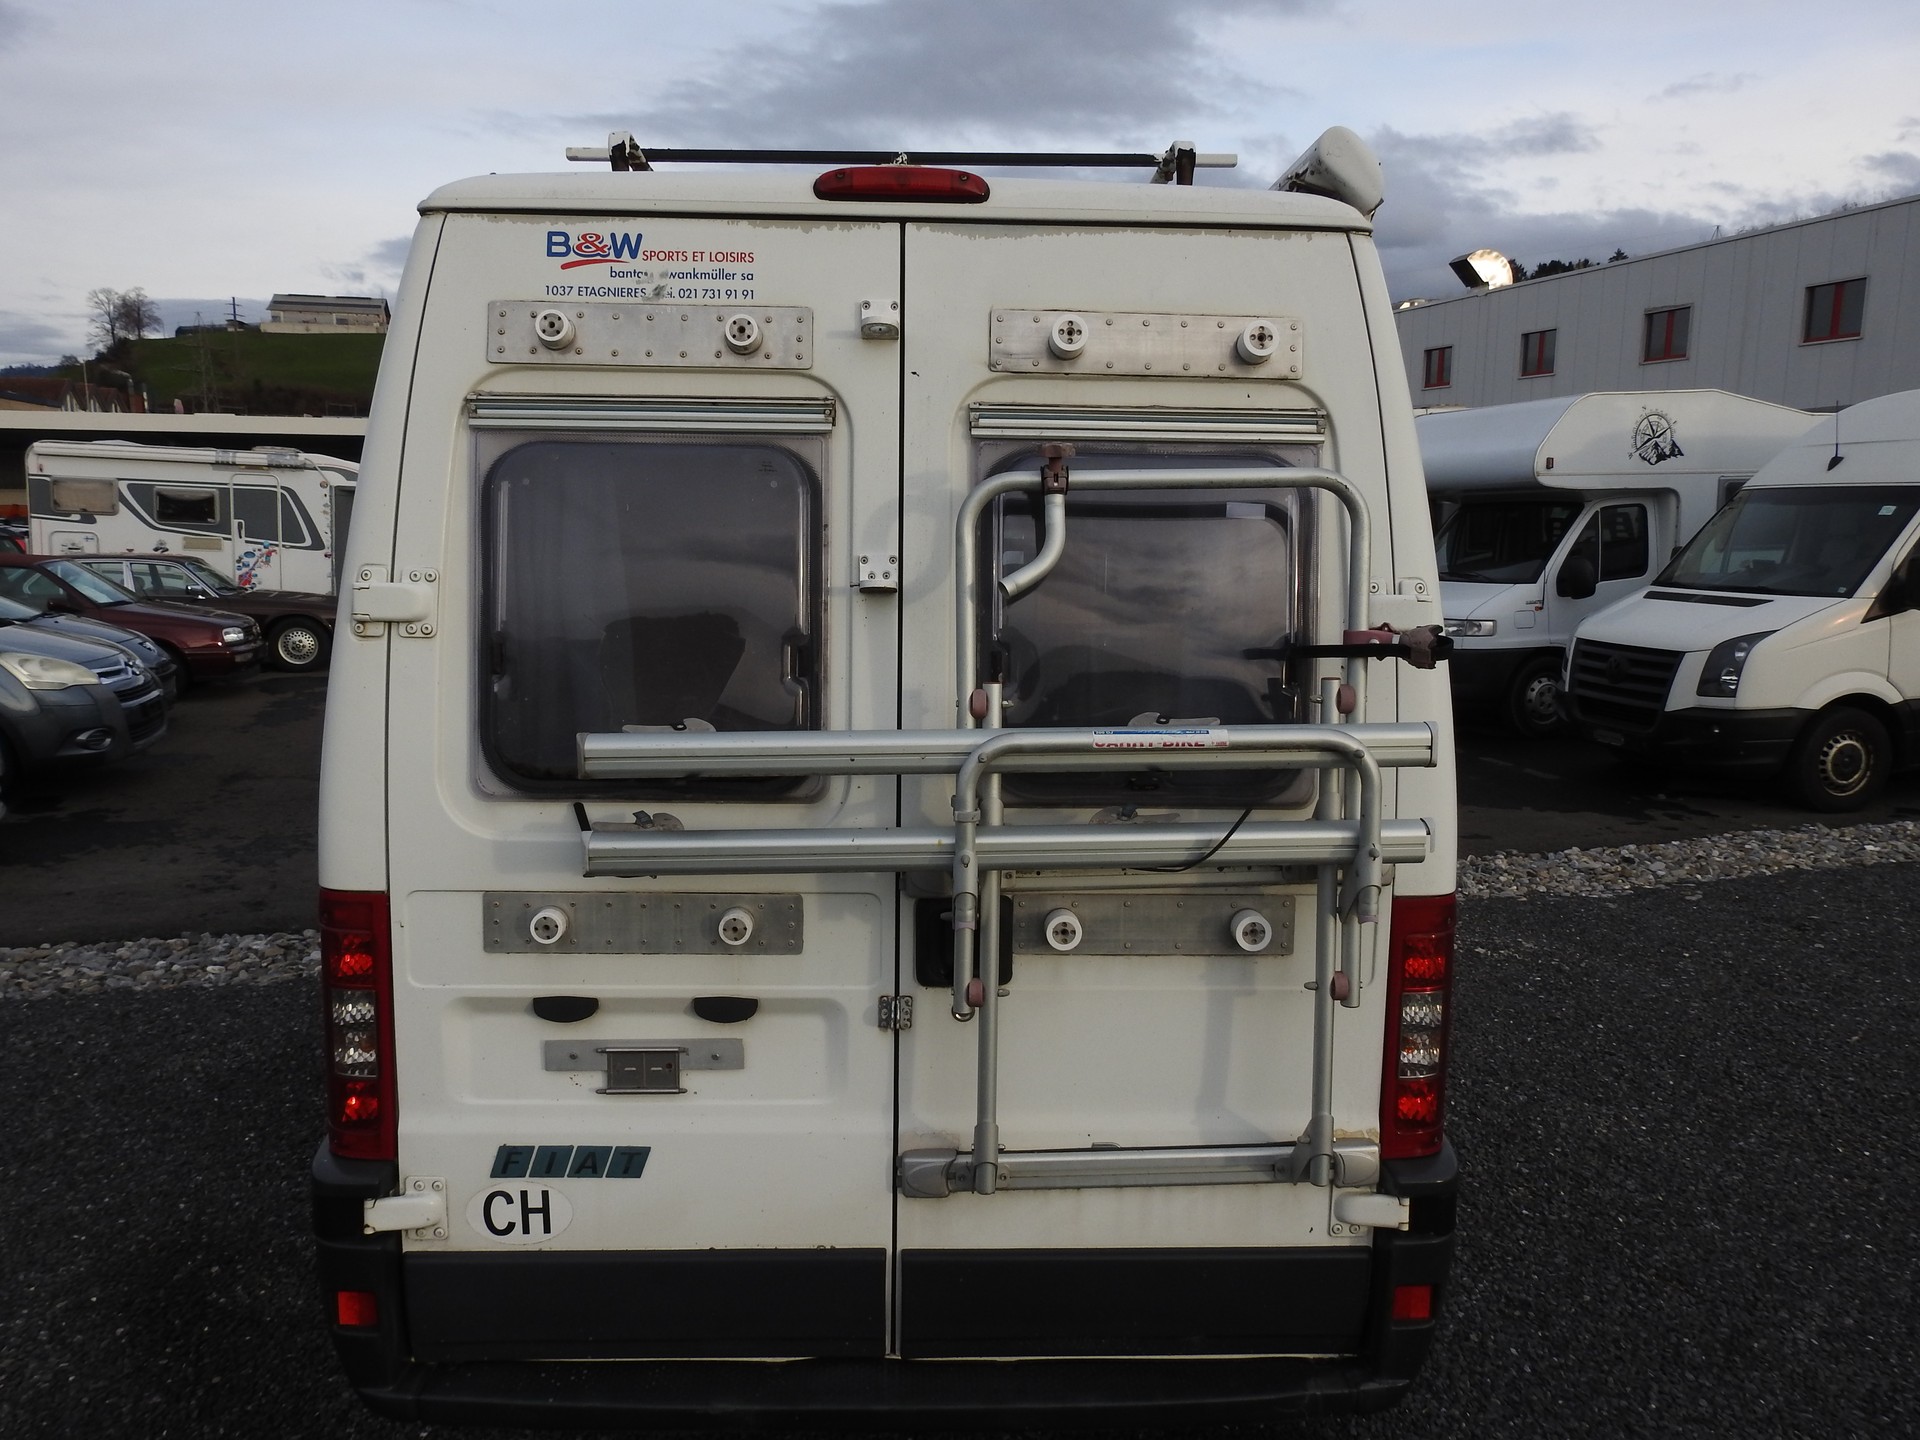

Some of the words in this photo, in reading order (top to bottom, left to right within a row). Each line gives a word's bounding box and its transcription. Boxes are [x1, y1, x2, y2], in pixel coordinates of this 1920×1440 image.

[546, 231, 643, 259] B&W
[642, 250, 688, 262] SPORTS
[692, 251, 705, 262] ET
[709, 251, 754, 263] LOISIRS
[740, 273, 754, 281] sa
[545, 285, 574, 296] 1037
[577, 286, 647, 298] ETAGNIERES
[678, 288, 698, 299] 021
[702, 288, 721, 299] 731
[725, 289, 738, 299] 91
[741, 289, 754, 300] 91
[500, 1151, 642, 1176] FIAT
[483, 1189, 552, 1237] CH
